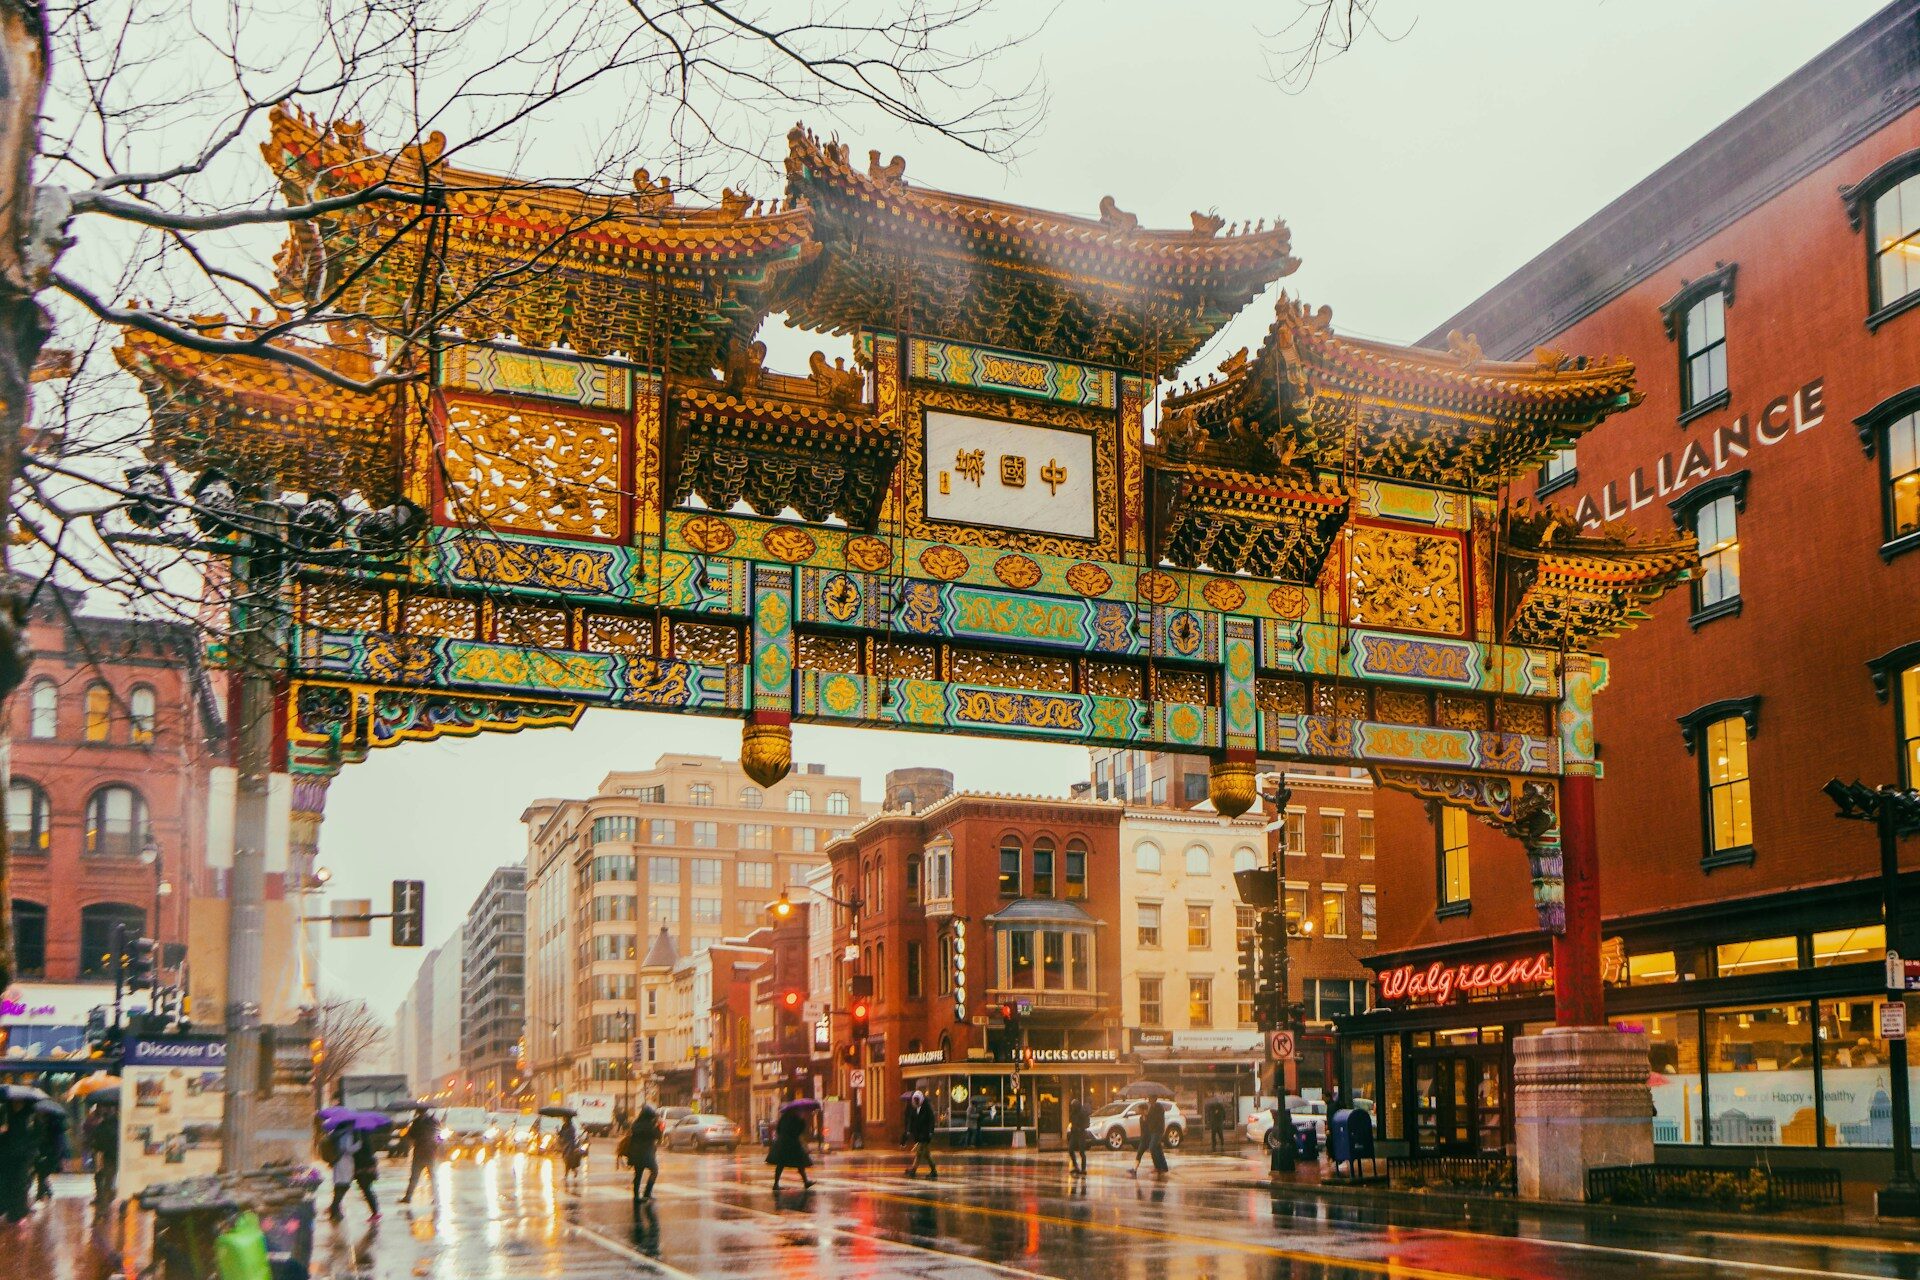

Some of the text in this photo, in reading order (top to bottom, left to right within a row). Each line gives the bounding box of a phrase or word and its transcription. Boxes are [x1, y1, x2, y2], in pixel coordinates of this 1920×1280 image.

[1575, 376, 1826, 530] ALLIANCE
[1378, 953, 1554, 1005] Walgreens
[135, 1041, 205, 1057] Discover
[1070, 1049, 1116, 1060] COFFEE
[898, 1049, 944, 1066] STARBUCKS COFFEE
[1772, 1091, 1804, 1103] Happy
[1823, 1090, 1857, 1103] ealthy
